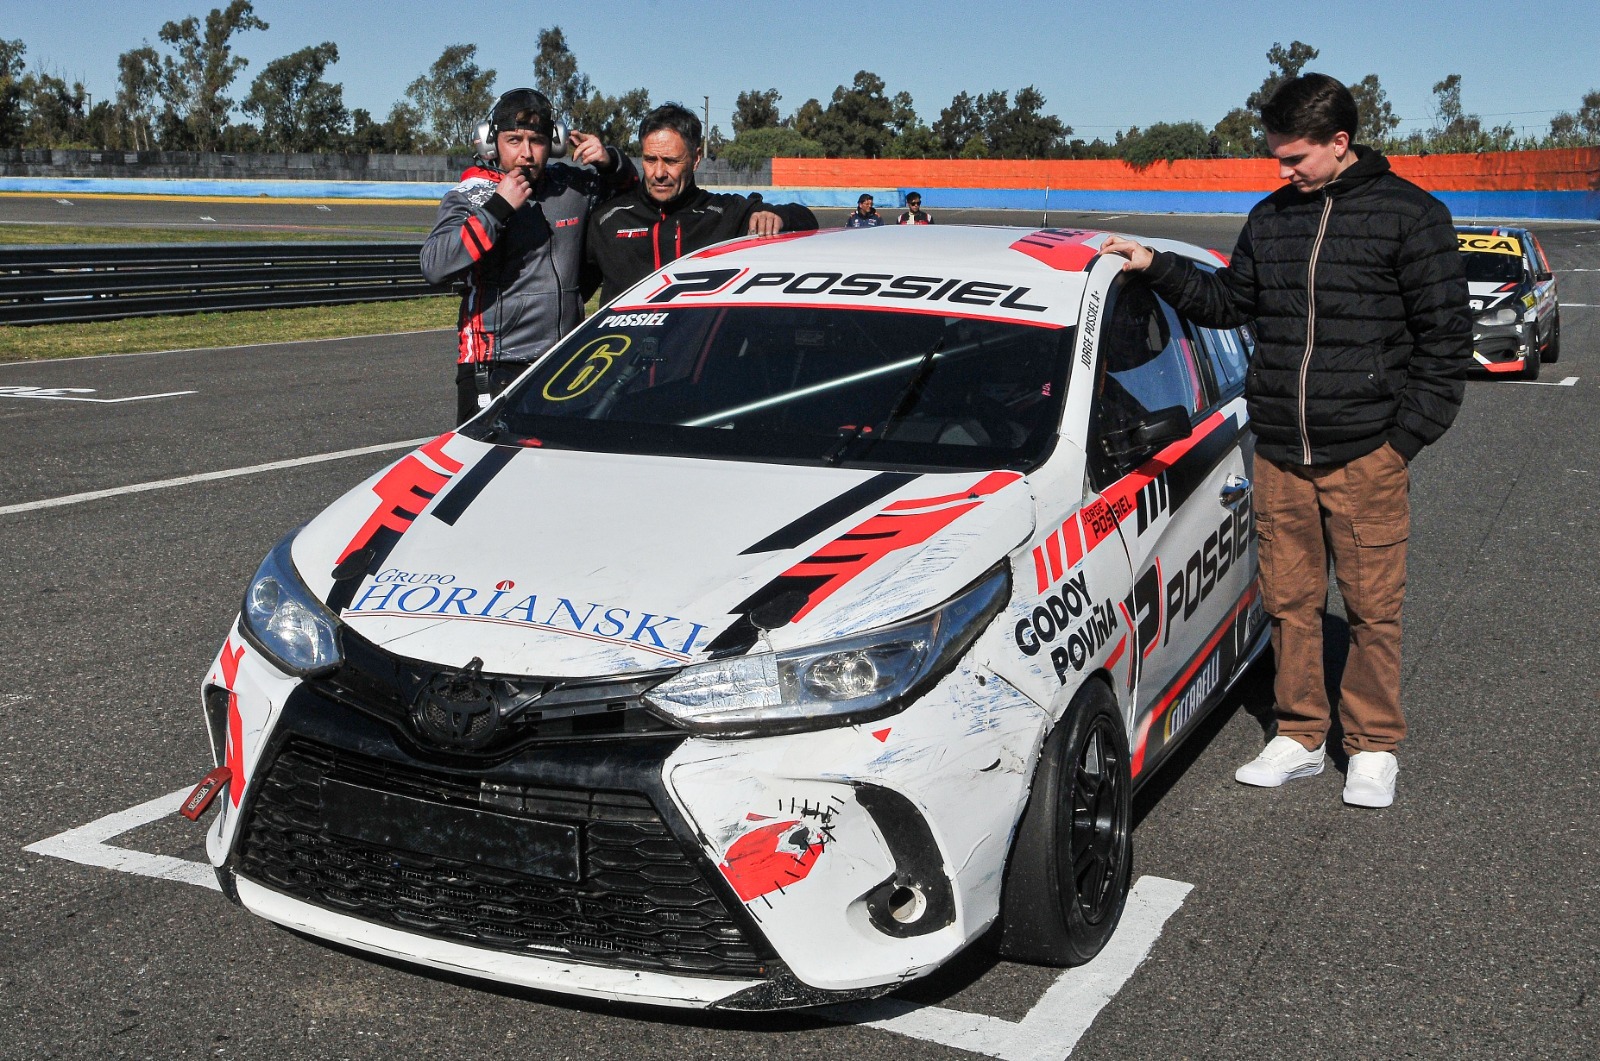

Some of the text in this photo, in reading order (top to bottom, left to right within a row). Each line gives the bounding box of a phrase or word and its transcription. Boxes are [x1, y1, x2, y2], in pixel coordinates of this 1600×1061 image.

[732, 271, 1048, 313] POSSIEL
[597, 312, 670, 329] POSSIEL
[1084, 301, 1099, 338] POSSIEL
[542, 334, 632, 401] 6
[1081, 335, 1094, 370] JORGE
[1082, 502, 1104, 525] JORGE
[1091, 494, 1133, 539] POSSIEL
[374, 568, 456, 584] GRUPO
[353, 582, 708, 657] HORIANSKI
[1014, 569, 1093, 657] GODOY
[1050, 597, 1119, 687] POVIÑA
